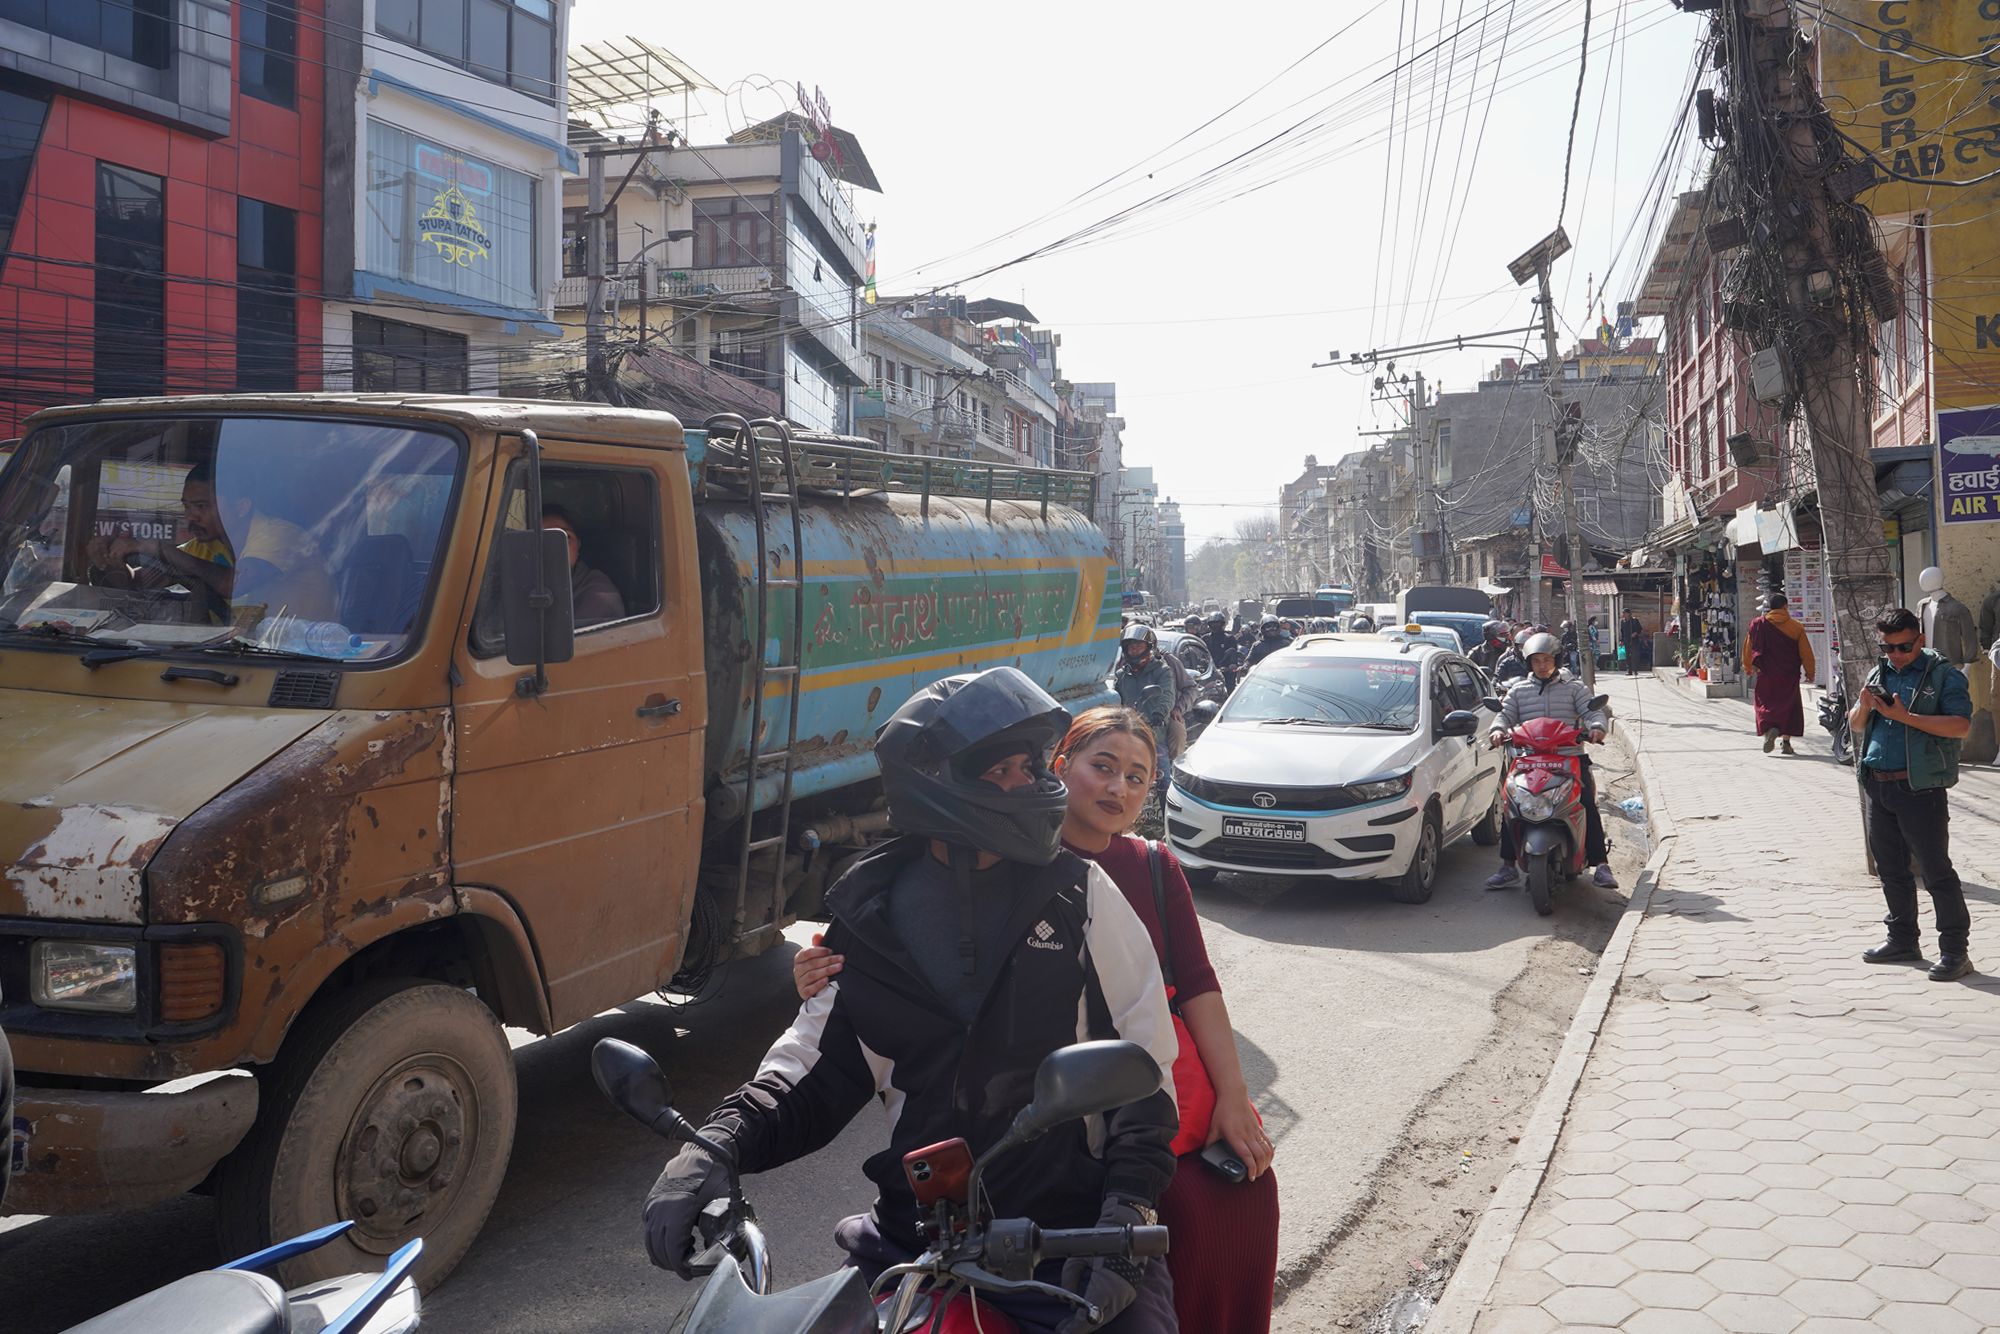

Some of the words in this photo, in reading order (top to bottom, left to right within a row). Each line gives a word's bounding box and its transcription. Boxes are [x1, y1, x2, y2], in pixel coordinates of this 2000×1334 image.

[1878, 1, 1917, 148] COLOR
[418, 219, 452, 231] STUPA
[456, 222, 492, 249] TATTOO
[1951, 496, 1988, 515] AIR
[121, 521, 173, 539] STORE
[1027, 936, 1064, 950] Columbia
